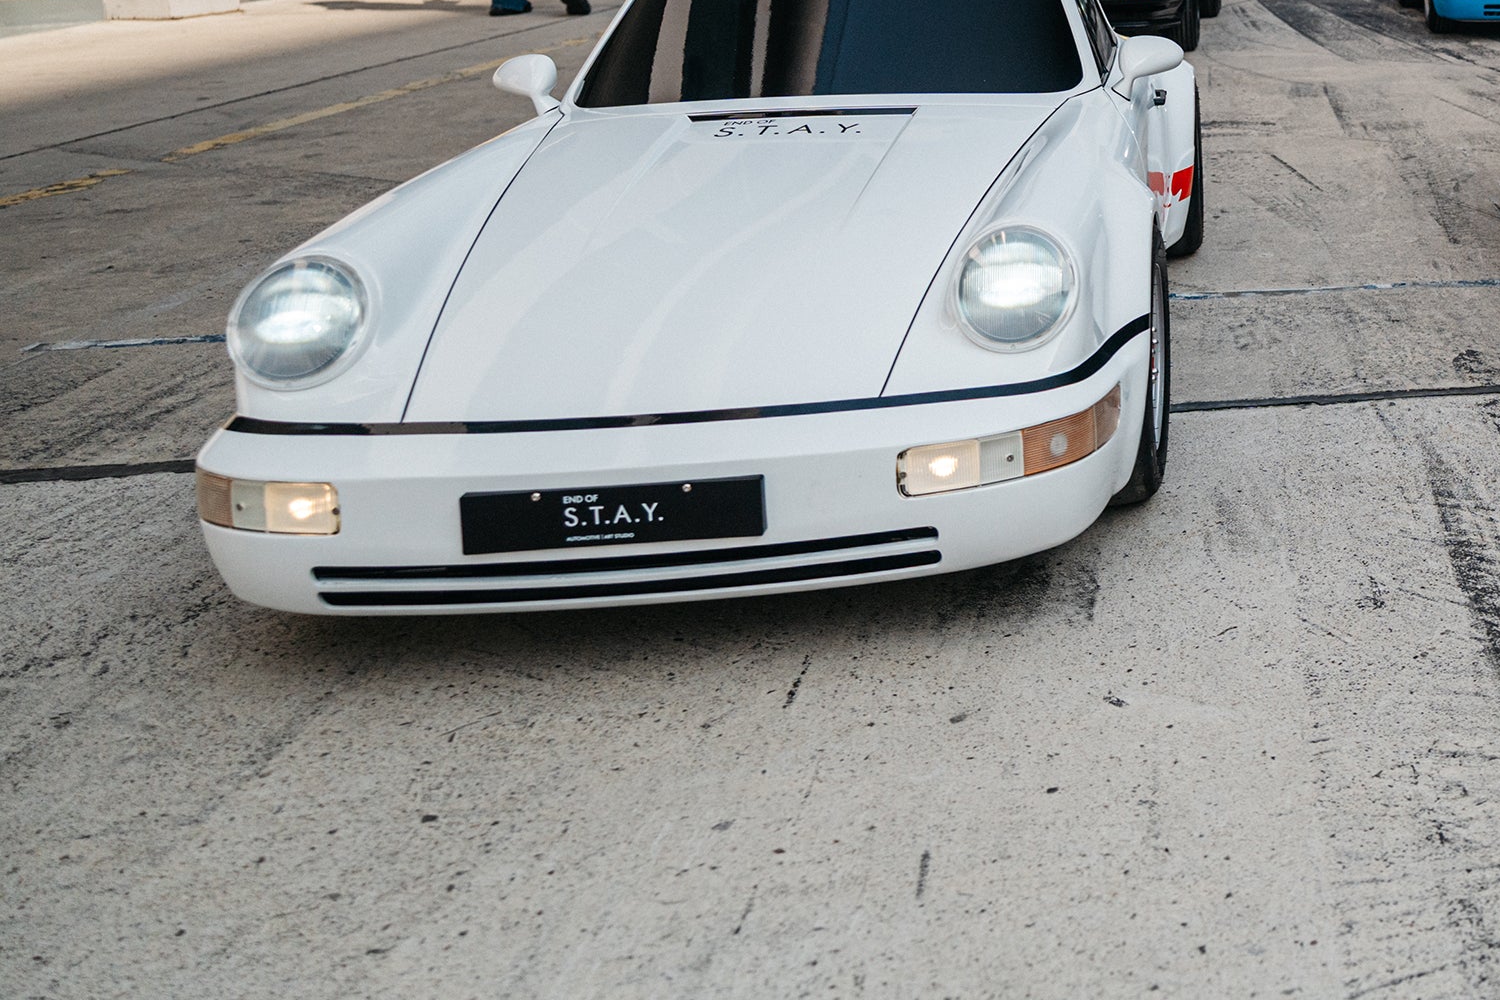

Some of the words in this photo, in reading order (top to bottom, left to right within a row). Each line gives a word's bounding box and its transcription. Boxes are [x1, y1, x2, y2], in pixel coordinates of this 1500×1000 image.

[714, 123, 861, 138] S.T.A.Y.
[563, 496, 584, 504] END
[585, 494, 599, 503] OF
[564, 502, 664, 527] S.T.A.Y.
